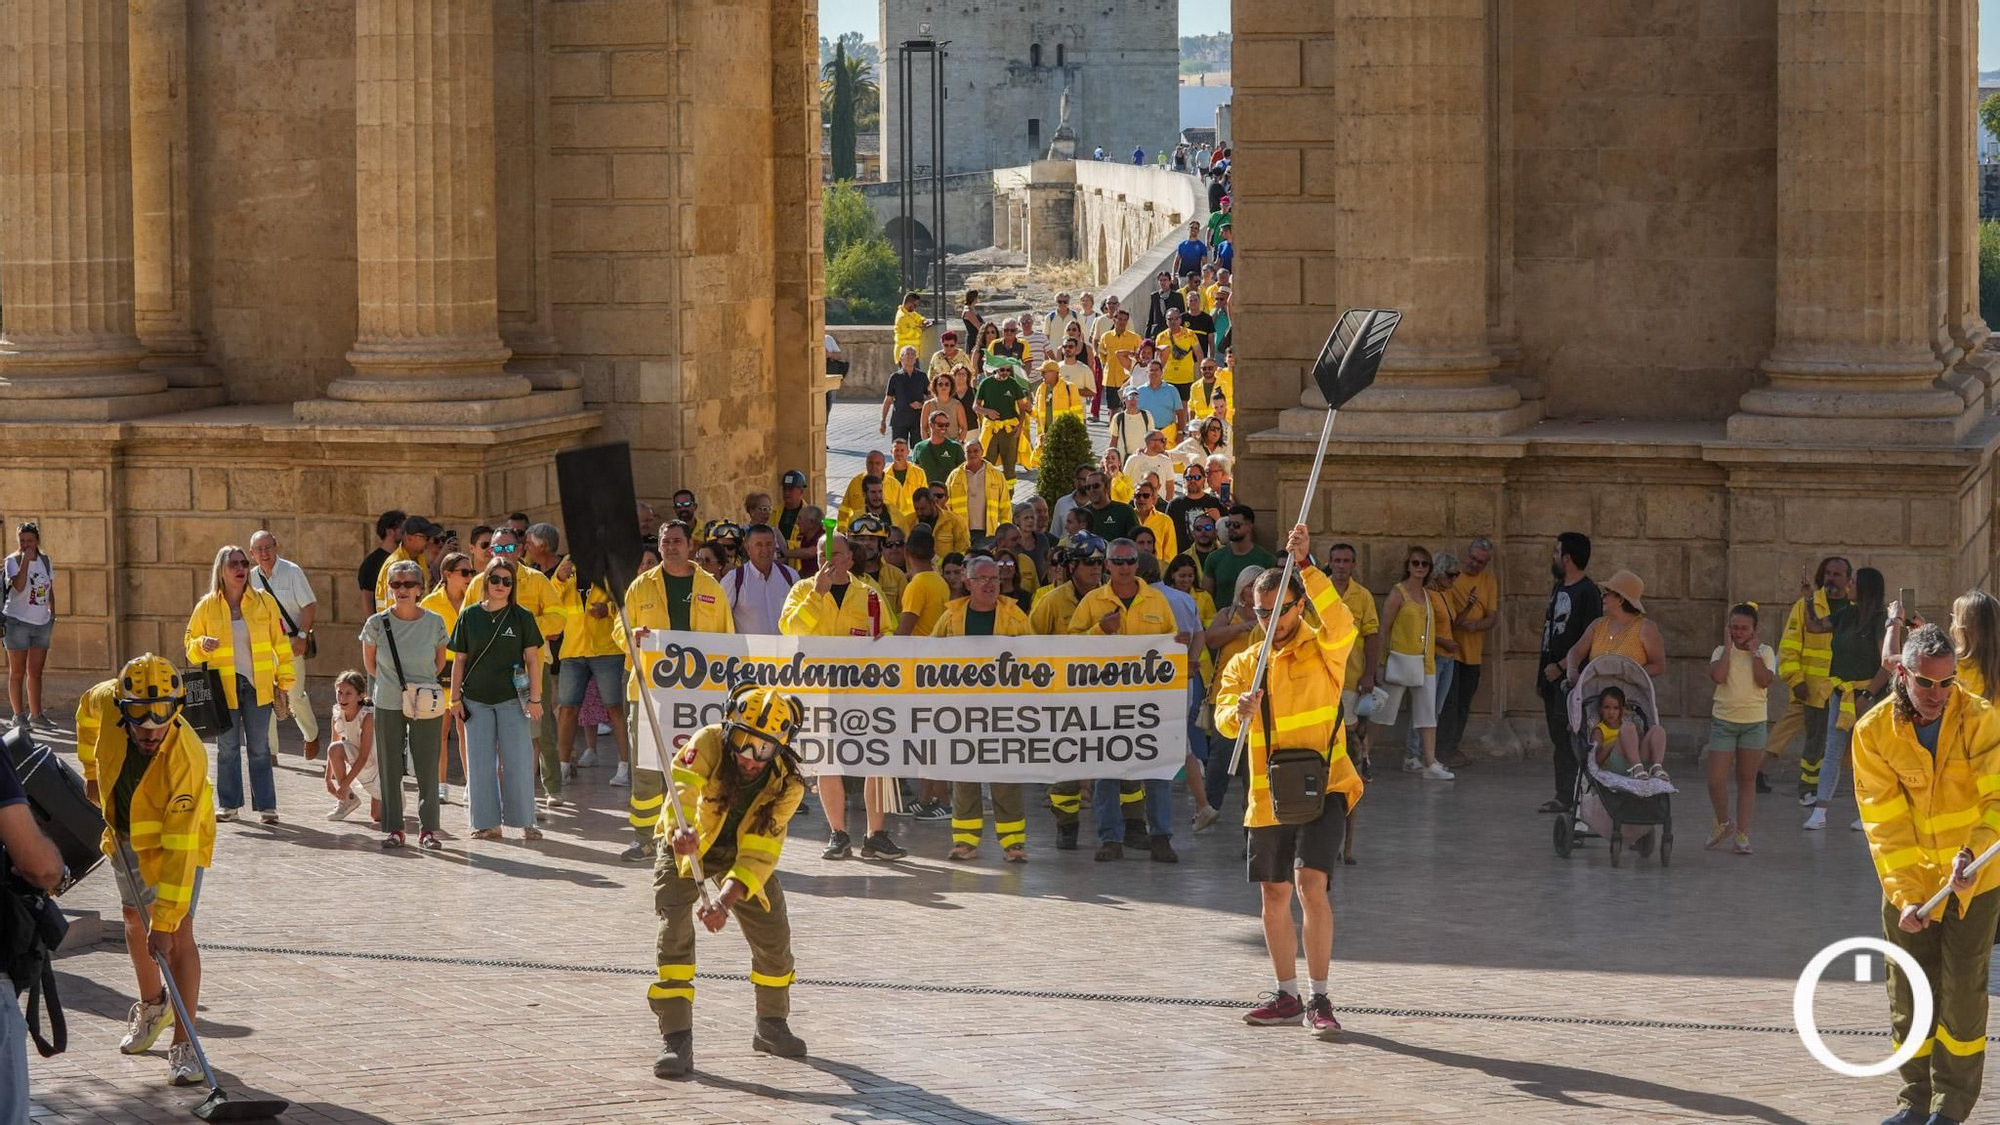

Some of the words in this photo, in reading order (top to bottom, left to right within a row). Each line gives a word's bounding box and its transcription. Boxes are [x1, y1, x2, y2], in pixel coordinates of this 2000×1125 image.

[652, 642, 901, 690] Defendamos
[915, 650, 1056, 687] nuestro
[1066, 648, 1175, 687] monte
[673, 702, 897, 737] BOER@S
[910, 702, 1161, 734] FORESTALES
[903, 738, 937, 766] NI
[949, 733, 1160, 765] DERECHOS
